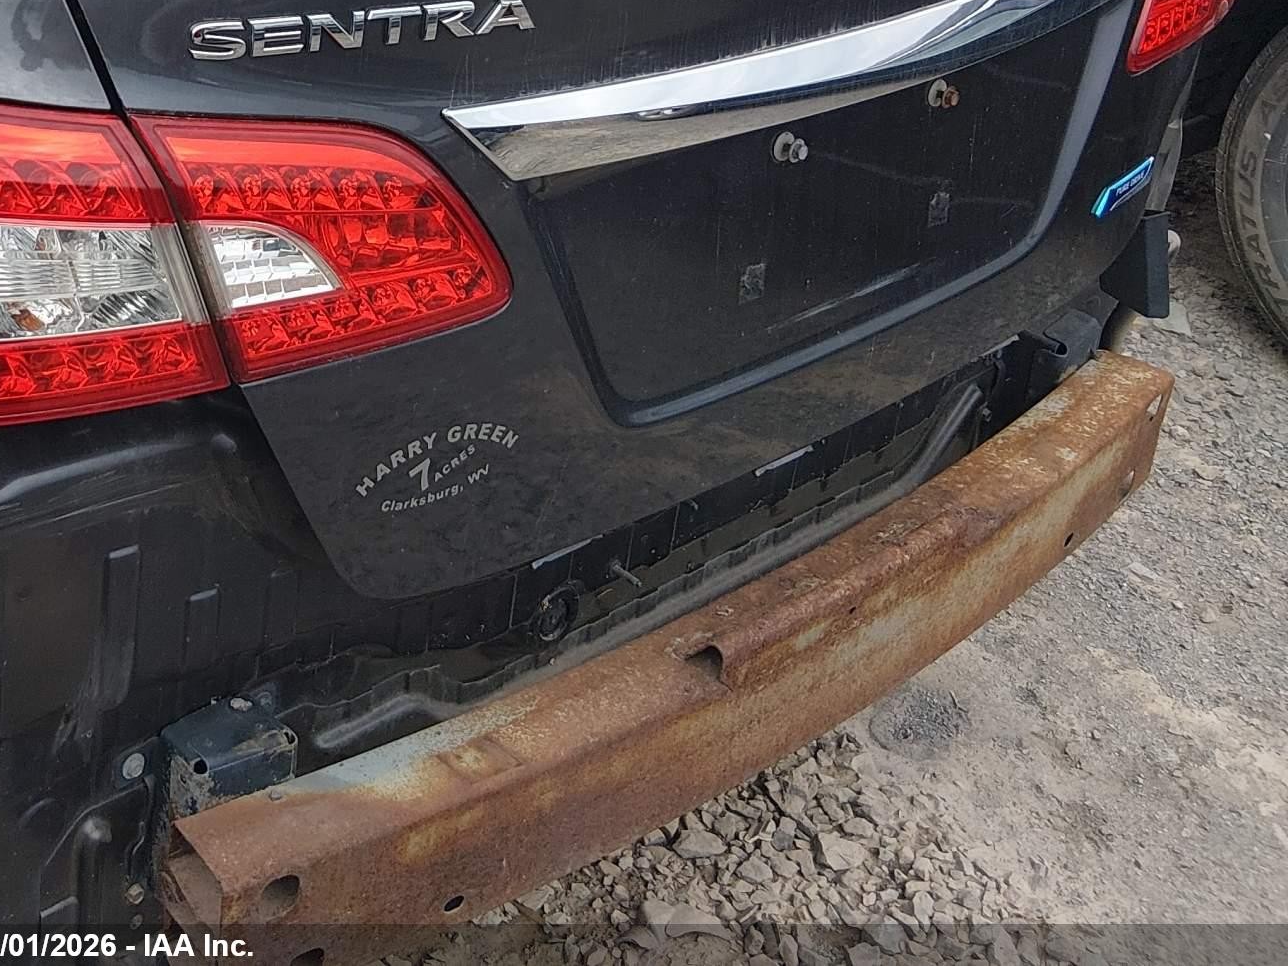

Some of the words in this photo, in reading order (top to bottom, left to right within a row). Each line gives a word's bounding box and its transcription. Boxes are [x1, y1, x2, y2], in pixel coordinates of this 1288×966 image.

[355, 432, 437, 497] HARRY
[447, 423, 519, 449] GREEN
[408, 458, 431, 491] 7
[433, 444, 476, 482] ACRES
[381, 482, 464, 512] Clarksburg,
[467, 463, 489, 485] WV
